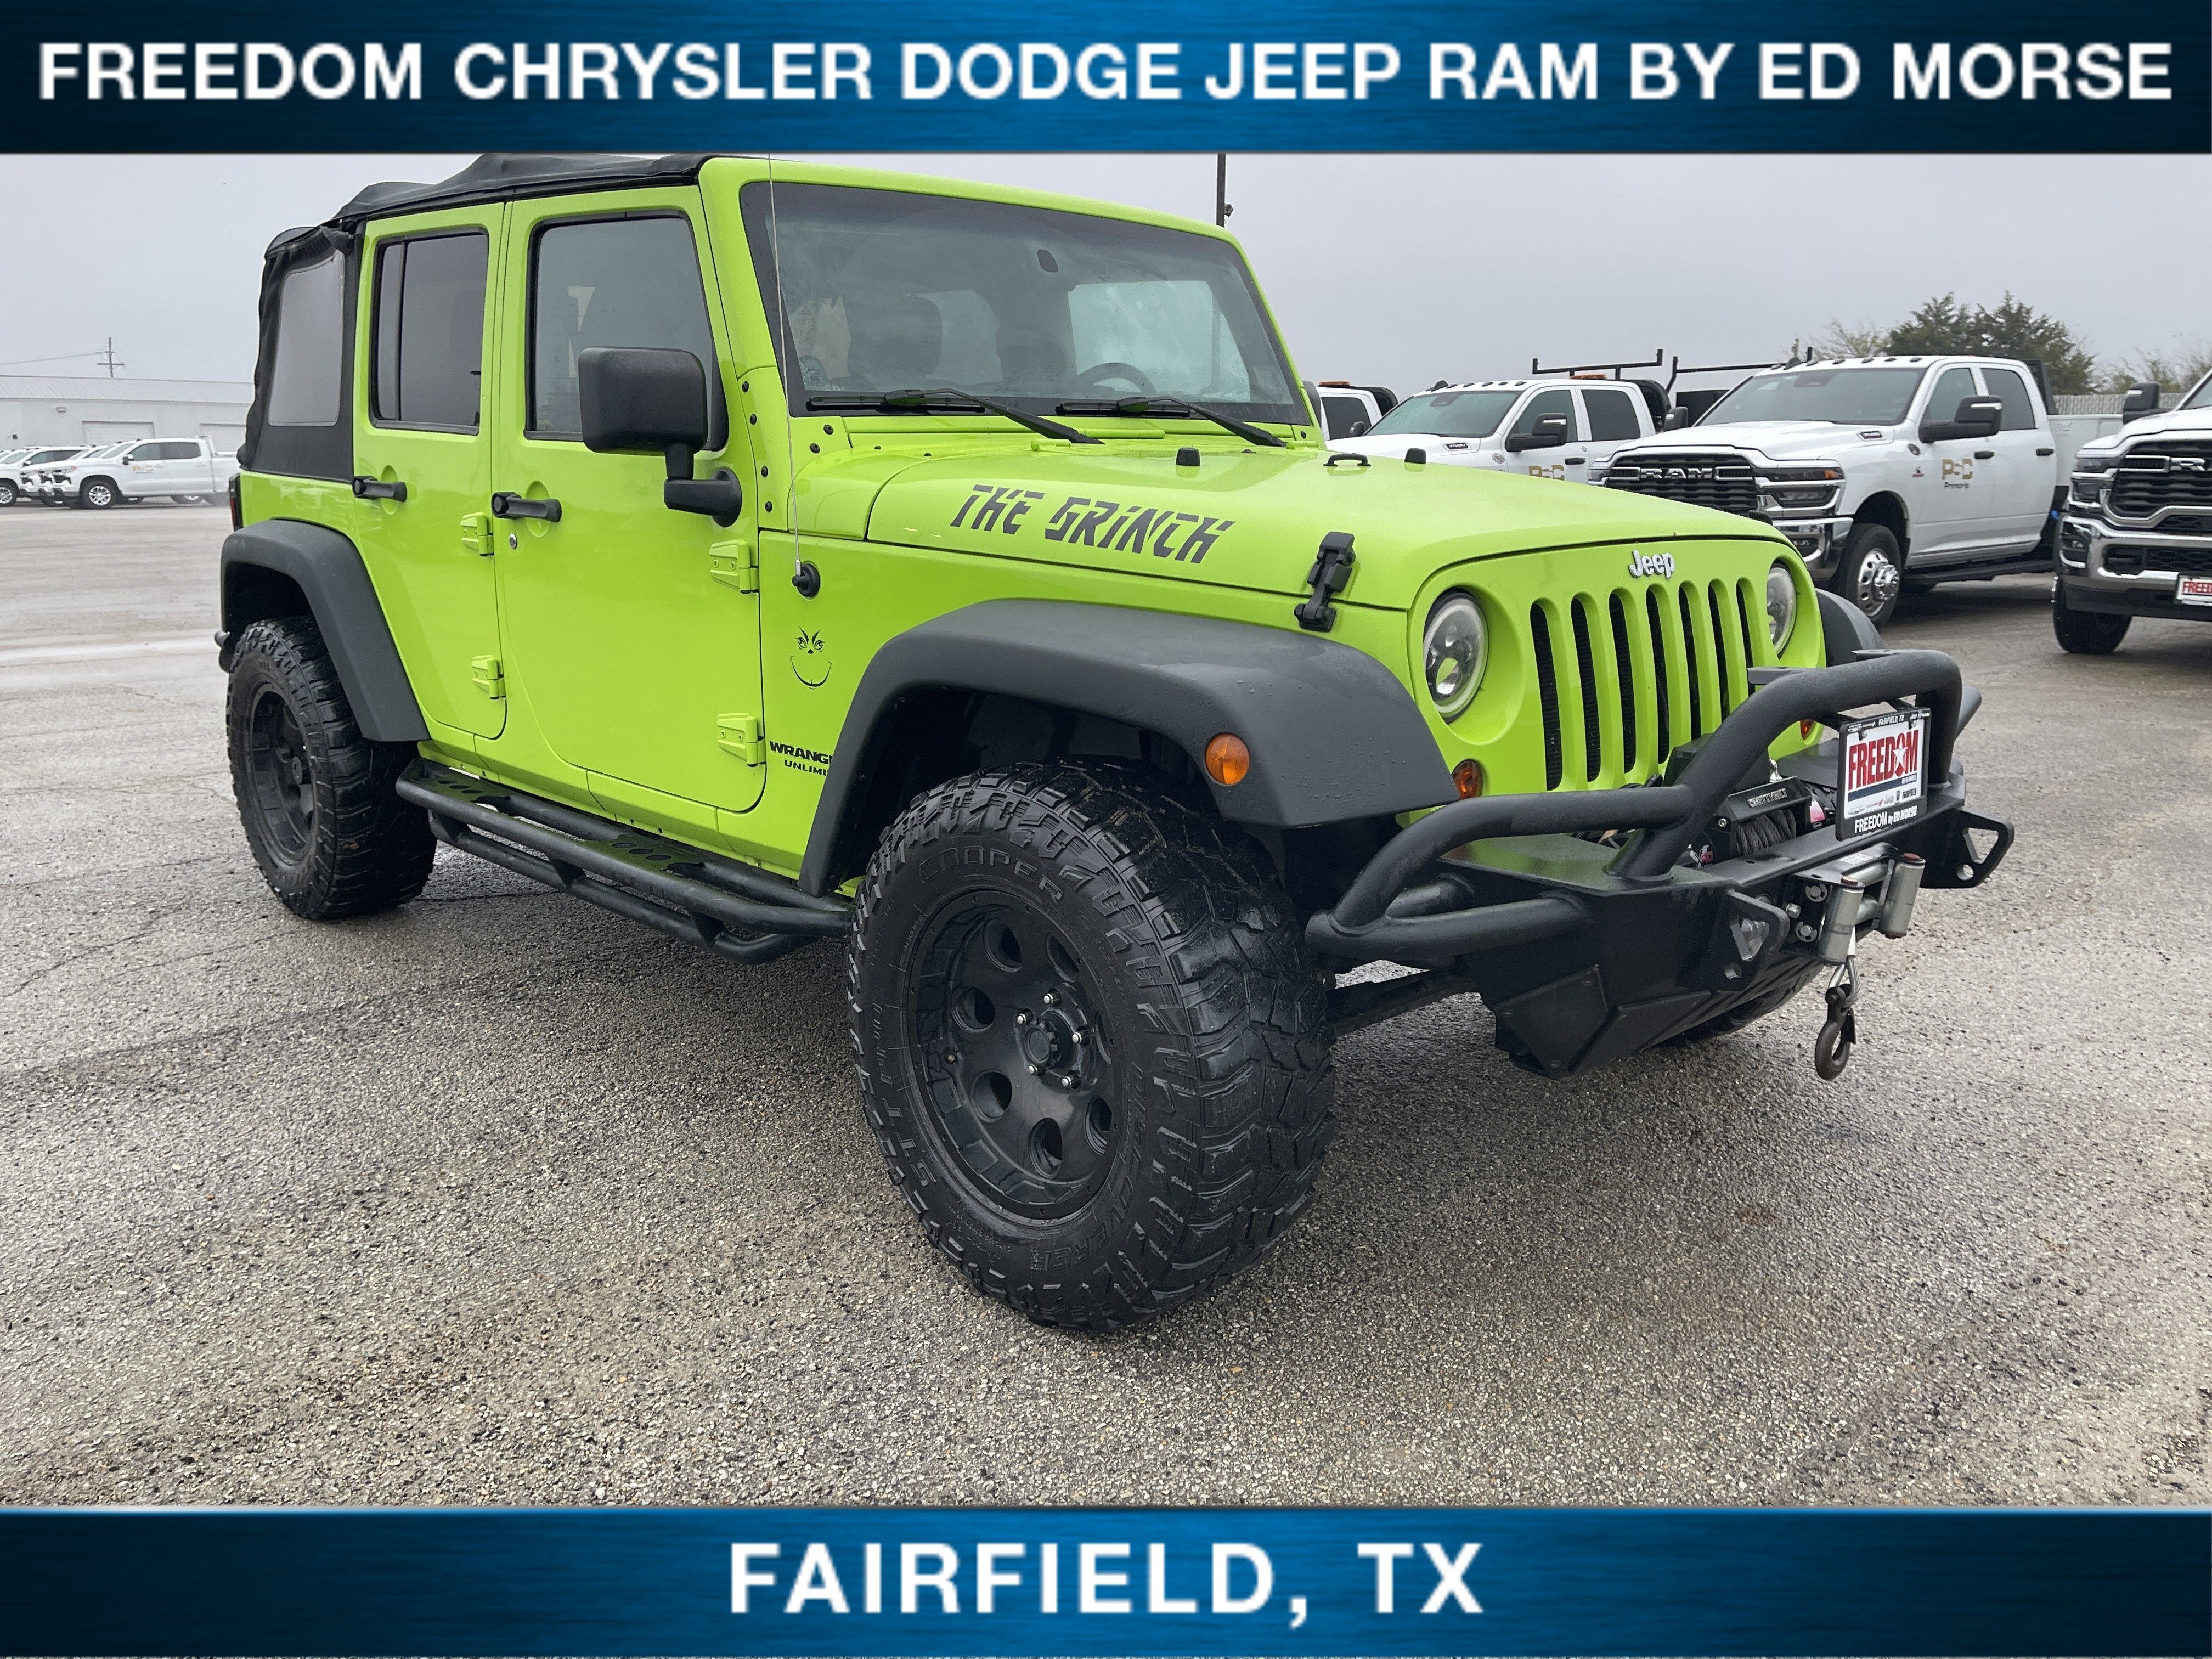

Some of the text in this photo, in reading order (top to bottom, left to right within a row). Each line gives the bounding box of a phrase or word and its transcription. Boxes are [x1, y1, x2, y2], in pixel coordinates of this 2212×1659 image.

[1640, 468, 1713, 479] RAM
[950, 484, 1045, 535] THE
[1628, 550, 1676, 579] Jeep
[784, 759, 828, 776] UNLIMI
[1848, 729, 1919, 791] FREEDOM
[1854, 811, 1888, 833] FREEDOM
[1893, 811, 1900, 822] ED
[918, 845, 1062, 904] COOPER
